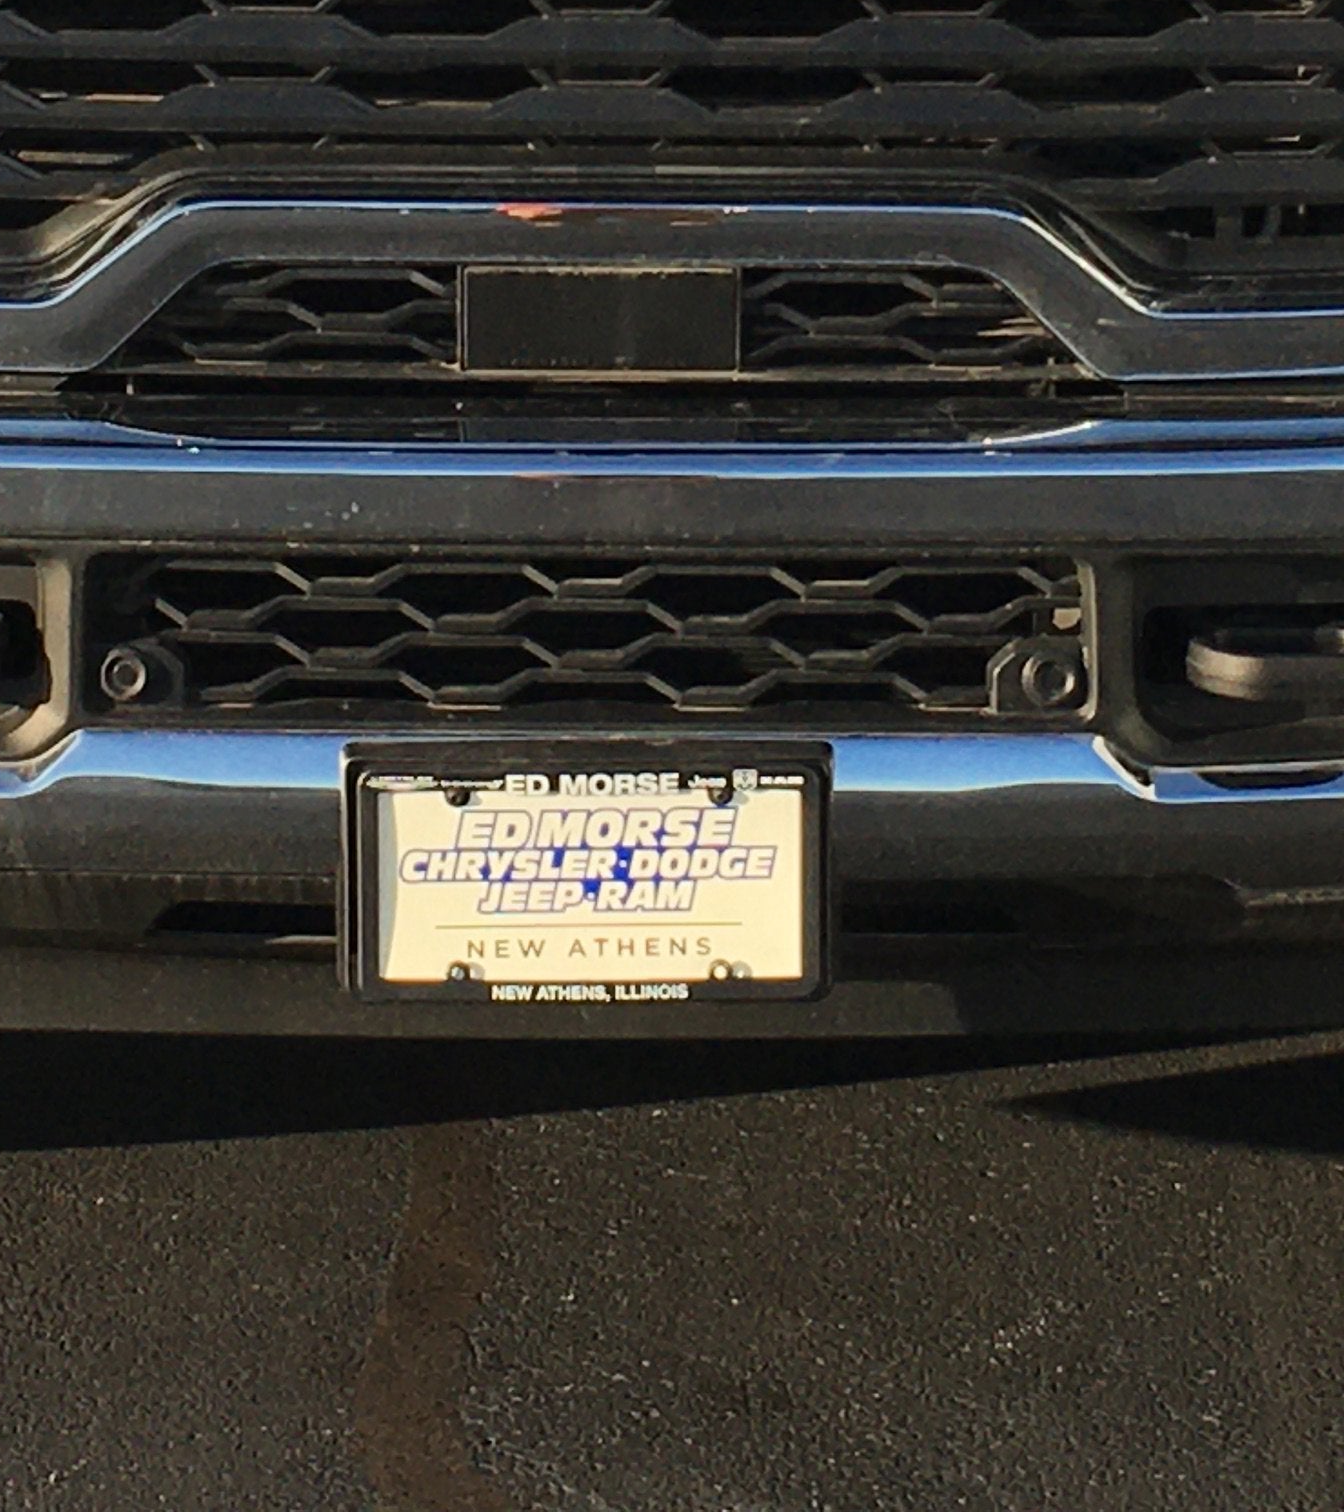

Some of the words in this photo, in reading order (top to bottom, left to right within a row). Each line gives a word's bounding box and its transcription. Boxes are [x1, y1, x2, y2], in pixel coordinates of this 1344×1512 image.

[505, 773, 550, 796] ED
[558, 772, 680, 796] MORSE
[455, 809, 533, 849] ED
[533, 806, 739, 849] MORSE
[466, 938, 546, 959] NEW
[568, 936, 712, 958] ATHENS
[491, 984, 533, 1001] NEW
[535, 983, 612, 1002] ATHENS,
[614, 982, 689, 1001] ILLINOIS
